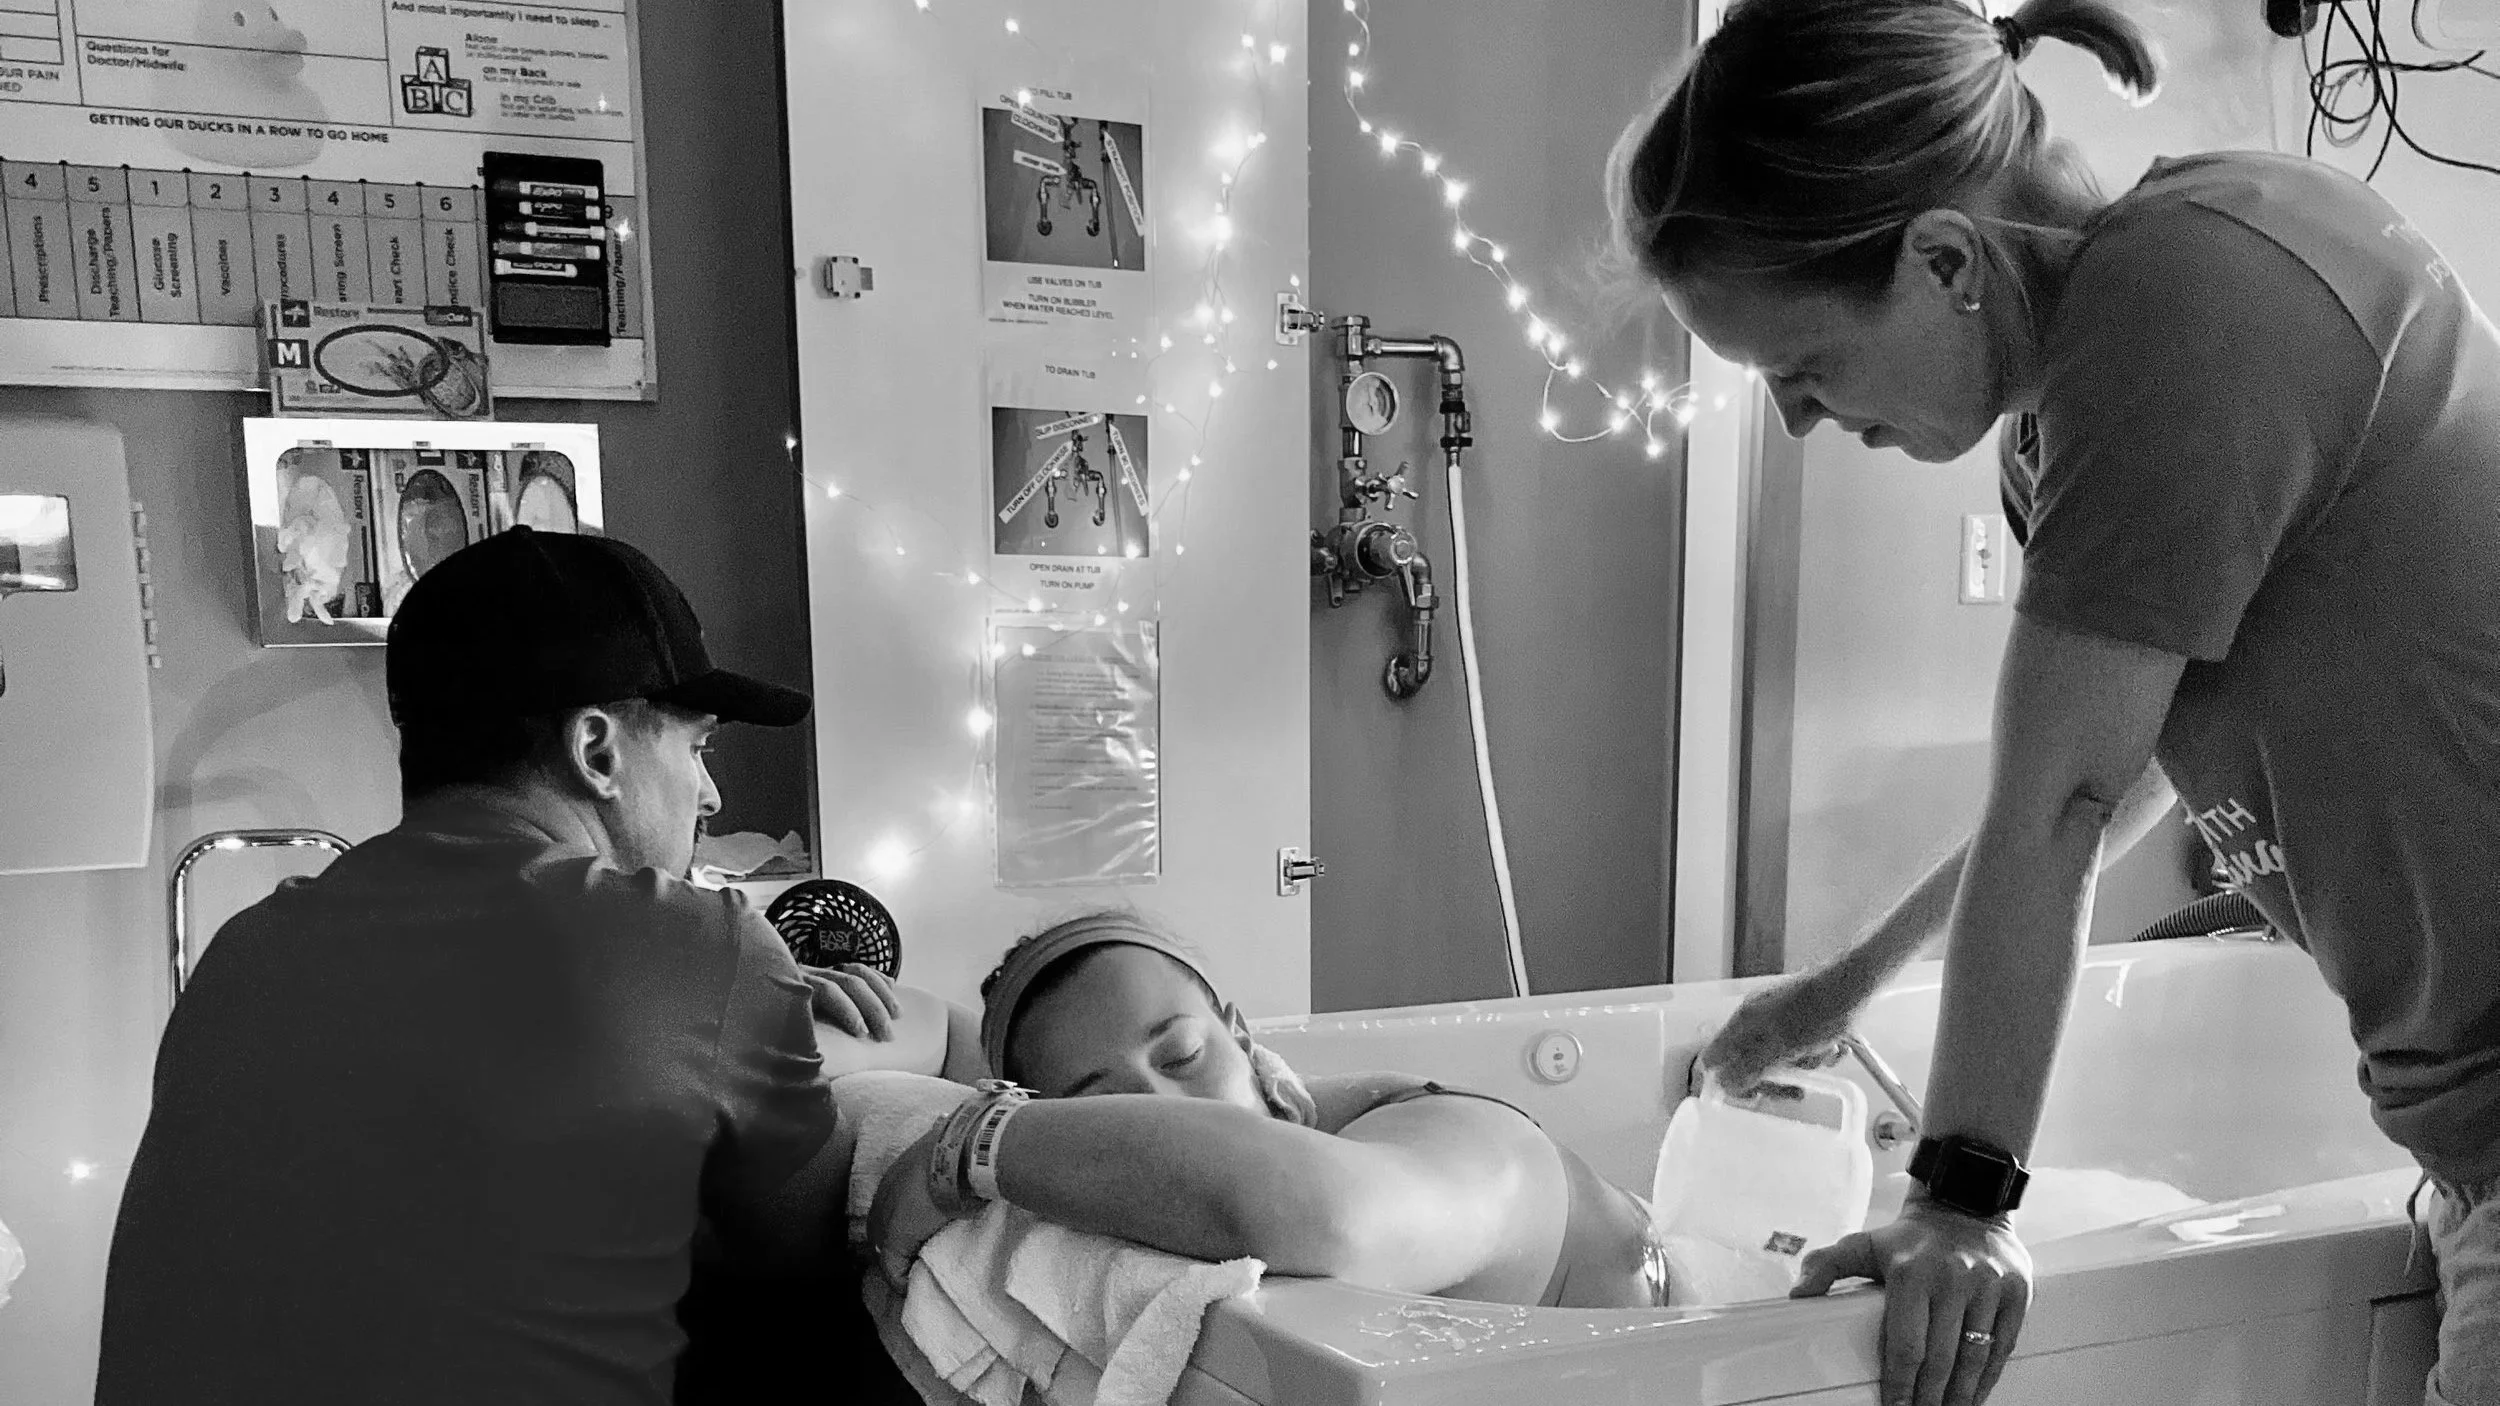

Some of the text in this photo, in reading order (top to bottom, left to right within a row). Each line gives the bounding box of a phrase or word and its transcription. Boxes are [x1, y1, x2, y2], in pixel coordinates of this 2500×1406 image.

[526, 13, 553, 24] need
[555, 16, 569, 25] to
[571, 17, 600, 28] sleep
[86, 40, 171, 56] Questions for
[87, 54, 186, 71] Doctor/Midwife
[423, 59, 444, 81] A
[28, 69, 60, 80] PAIN
[520, 67, 547, 78] Back
[411, 88, 464, 112] B C
[89, 112, 390, 144] GETTING OUR DUCKS IN A ROW TO GO HOME
[24, 173, 39, 189] 4
[87, 176, 100, 192] 5
[151, 180, 159, 196] 1
[210, 183, 222, 199] 2
[268, 186, 281, 203] 3
[326, 190, 340, 206] 4
[384, 192, 396, 209] 5
[439, 196, 453, 212] 6
[33, 214, 51, 302] Prescriptions
[87, 227, 102, 295] Discharge
[151, 237, 165, 291] Glucose
[167, 232, 182, 298] Screening
[332, 222, 348, 303] aring Screen
[443, 227, 460, 306] ndice Check
[218, 239, 231, 296] Vaccines
[389, 235, 404, 304] eart Check
[1074, 279, 1086, 288] ON
[1087, 280, 1102, 289] TUB
[1028, 293, 1049, 304] TURN
[1050, 296, 1062, 305] ON
[1002, 300, 1026, 310] WHEN
[1027, 303, 1054, 313] WATER
[1092, 310, 1114, 320] LEVEL
[277, 342, 301, 366] M
[1045, 365, 1096, 379] TO DRAIN TUB
[1112, 430, 1125, 456] TURN
[353, 474, 364, 520] Restore
[468, 473, 480, 518] Restore
[1006, 494, 1025, 515] TURN
[1023, 480, 1037, 496] OFF
[1029, 563, 1050, 572] OPEN
[1051, 564, 1074, 573] DRAIN
[1087, 566, 1101, 574] TUB
[1040, 580, 1095, 590] TURN ON PUMP
